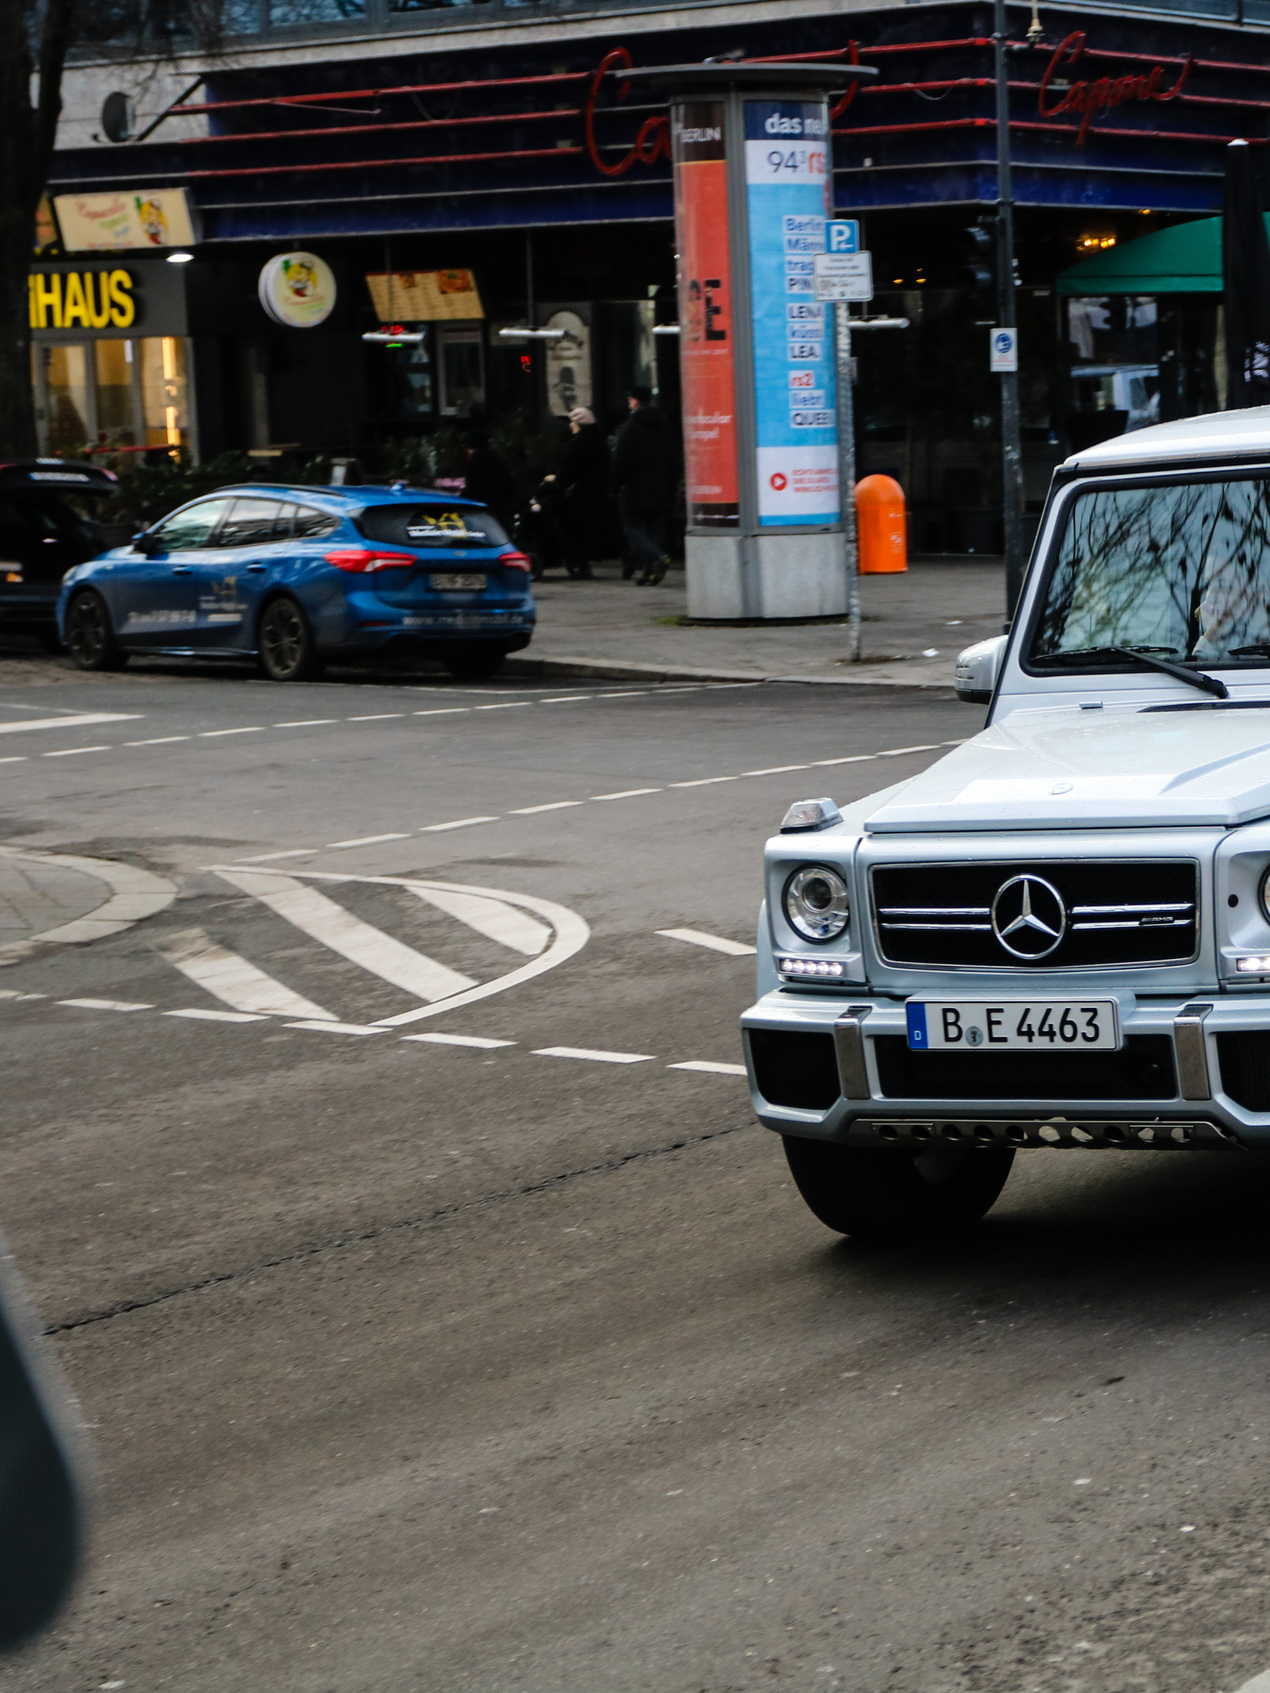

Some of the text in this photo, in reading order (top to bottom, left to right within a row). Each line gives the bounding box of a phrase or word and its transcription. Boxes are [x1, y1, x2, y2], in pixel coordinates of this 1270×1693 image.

[1038, 30, 1195, 147] Capone
[765, 113, 802, 134] das
[808, 151, 825, 175] rs
[830, 225, 851, 251] P
[942, 1007, 1100, 1043] B E 4463
